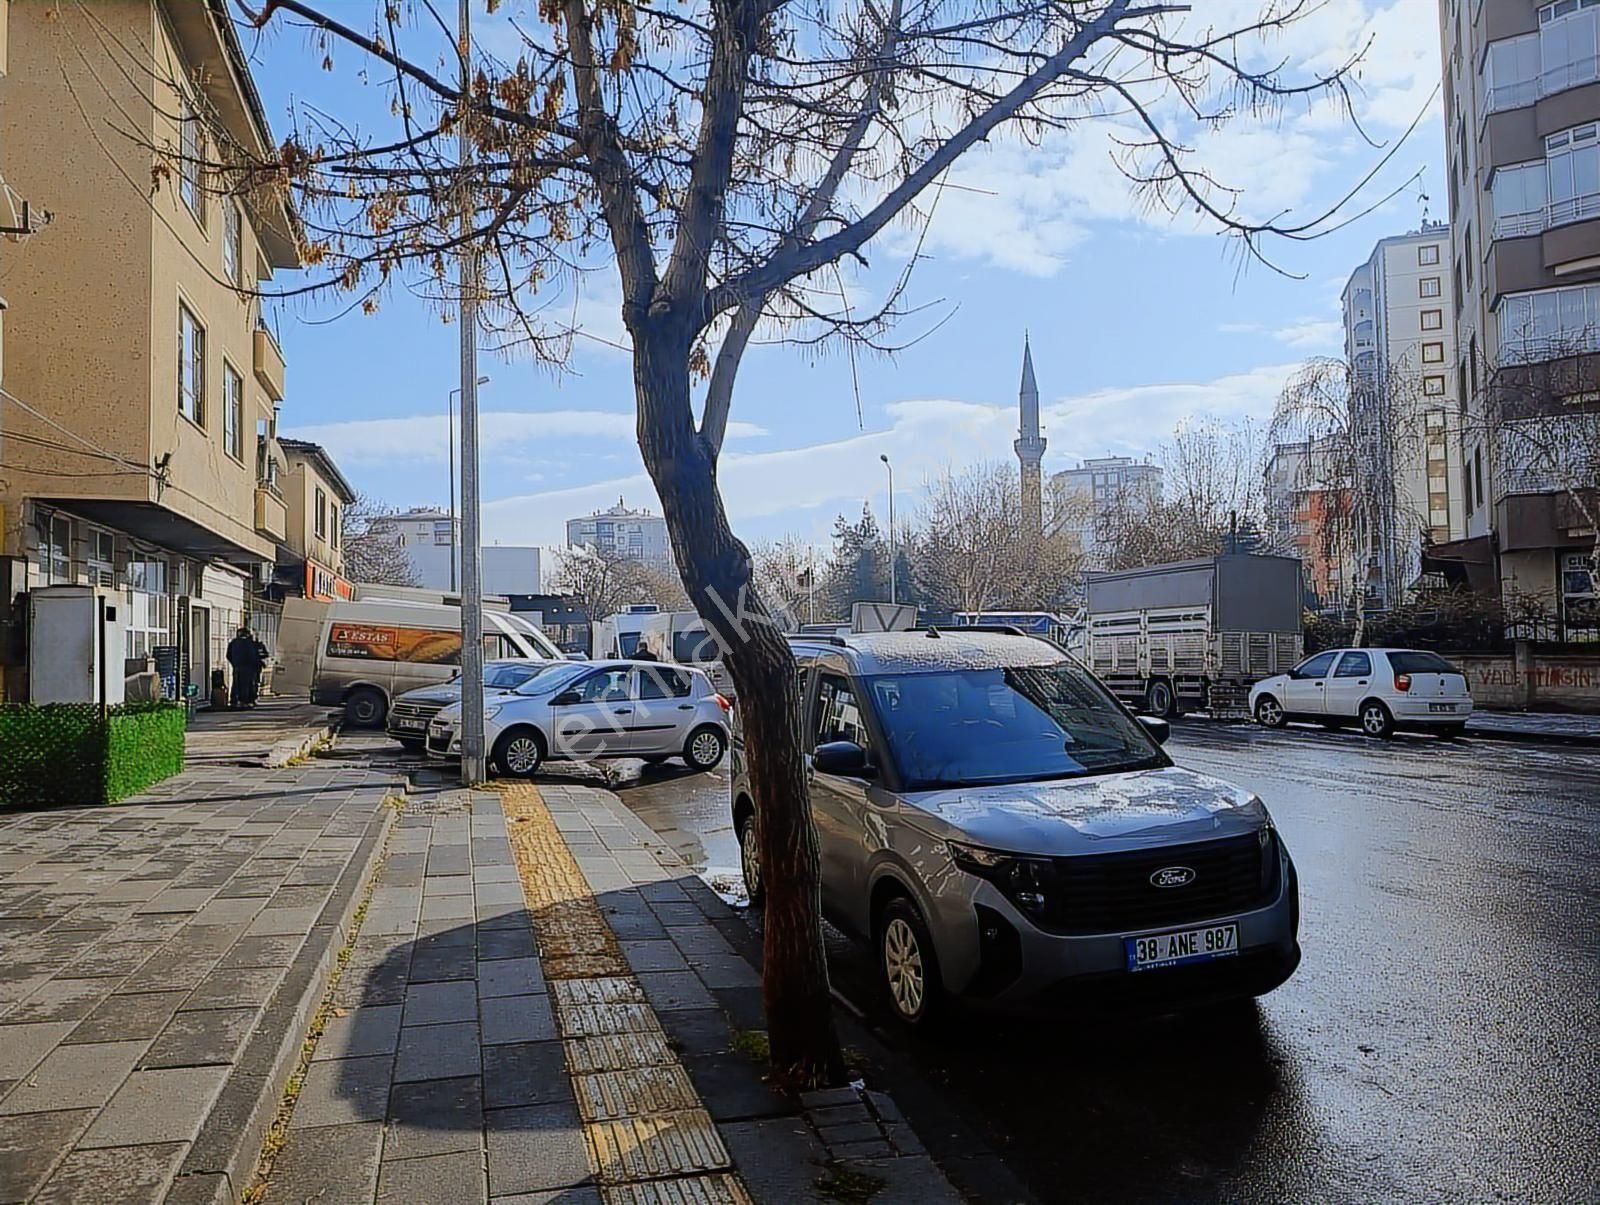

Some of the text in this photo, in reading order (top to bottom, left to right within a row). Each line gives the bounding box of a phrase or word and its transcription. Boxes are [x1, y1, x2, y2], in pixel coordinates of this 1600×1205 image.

[1159, 870, 1188, 885] Ford
[1137, 926, 1235, 962] 38 ANE 987
